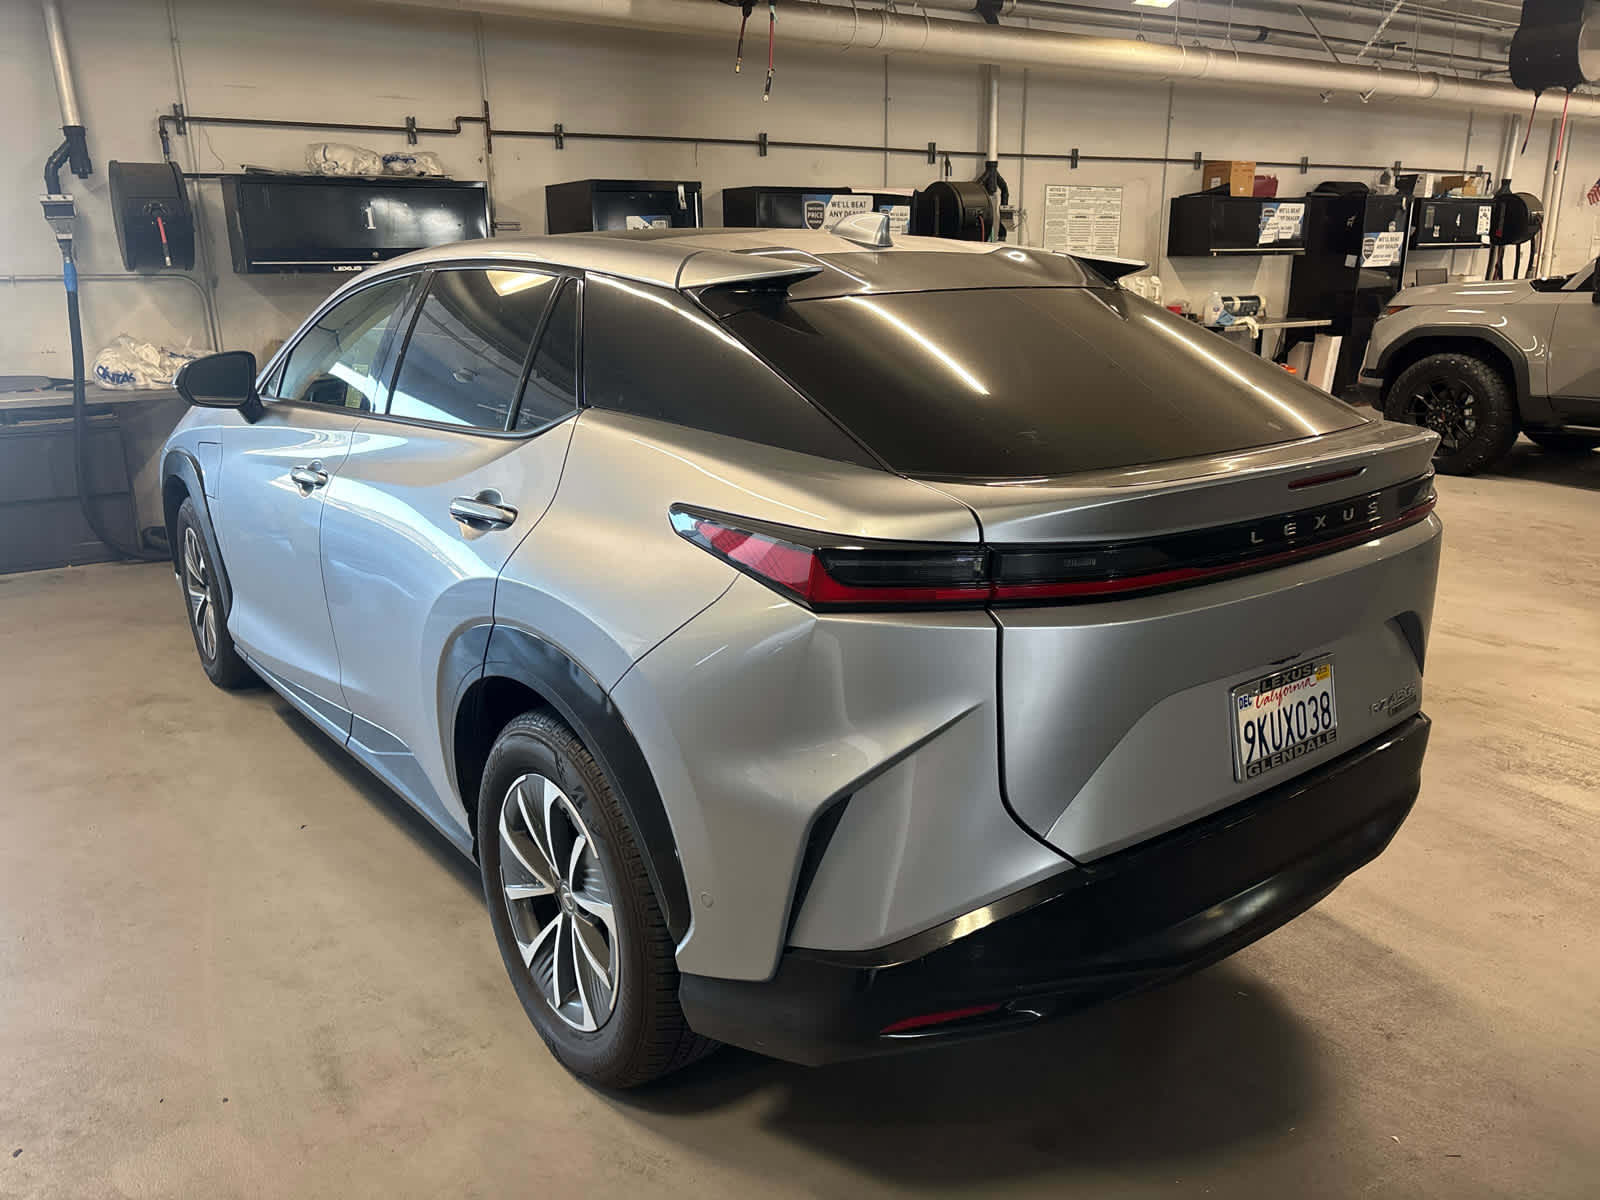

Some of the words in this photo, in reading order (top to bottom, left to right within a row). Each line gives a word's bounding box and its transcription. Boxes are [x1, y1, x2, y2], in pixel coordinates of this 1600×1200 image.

[365, 207, 376, 230] 1
[1251, 501, 1378, 543] LEXUS
[1255, 677, 1317, 709] California
[1261, 665, 1313, 691] LEXUS
[1239, 696, 1252, 710] DEC
[1244, 691, 1332, 764] 9KUX038
[1247, 730, 1337, 777] GLENDALE
